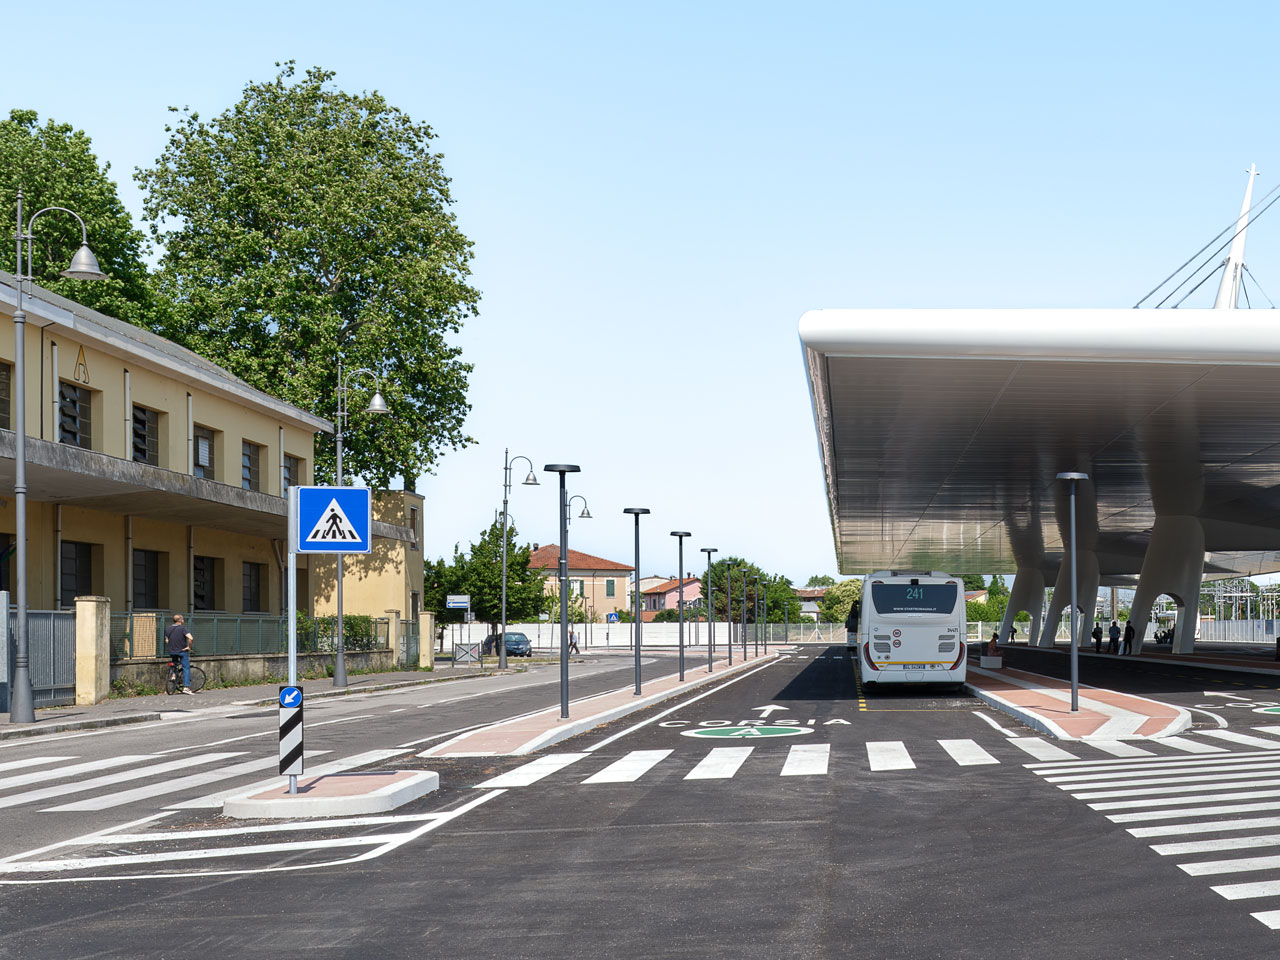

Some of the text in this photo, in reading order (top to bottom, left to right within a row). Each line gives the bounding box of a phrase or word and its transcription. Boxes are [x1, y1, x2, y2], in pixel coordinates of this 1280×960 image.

[906, 587, 924, 600] 241
[658, 718, 852, 728] CORSIA
[729, 727, 763, 736] A
